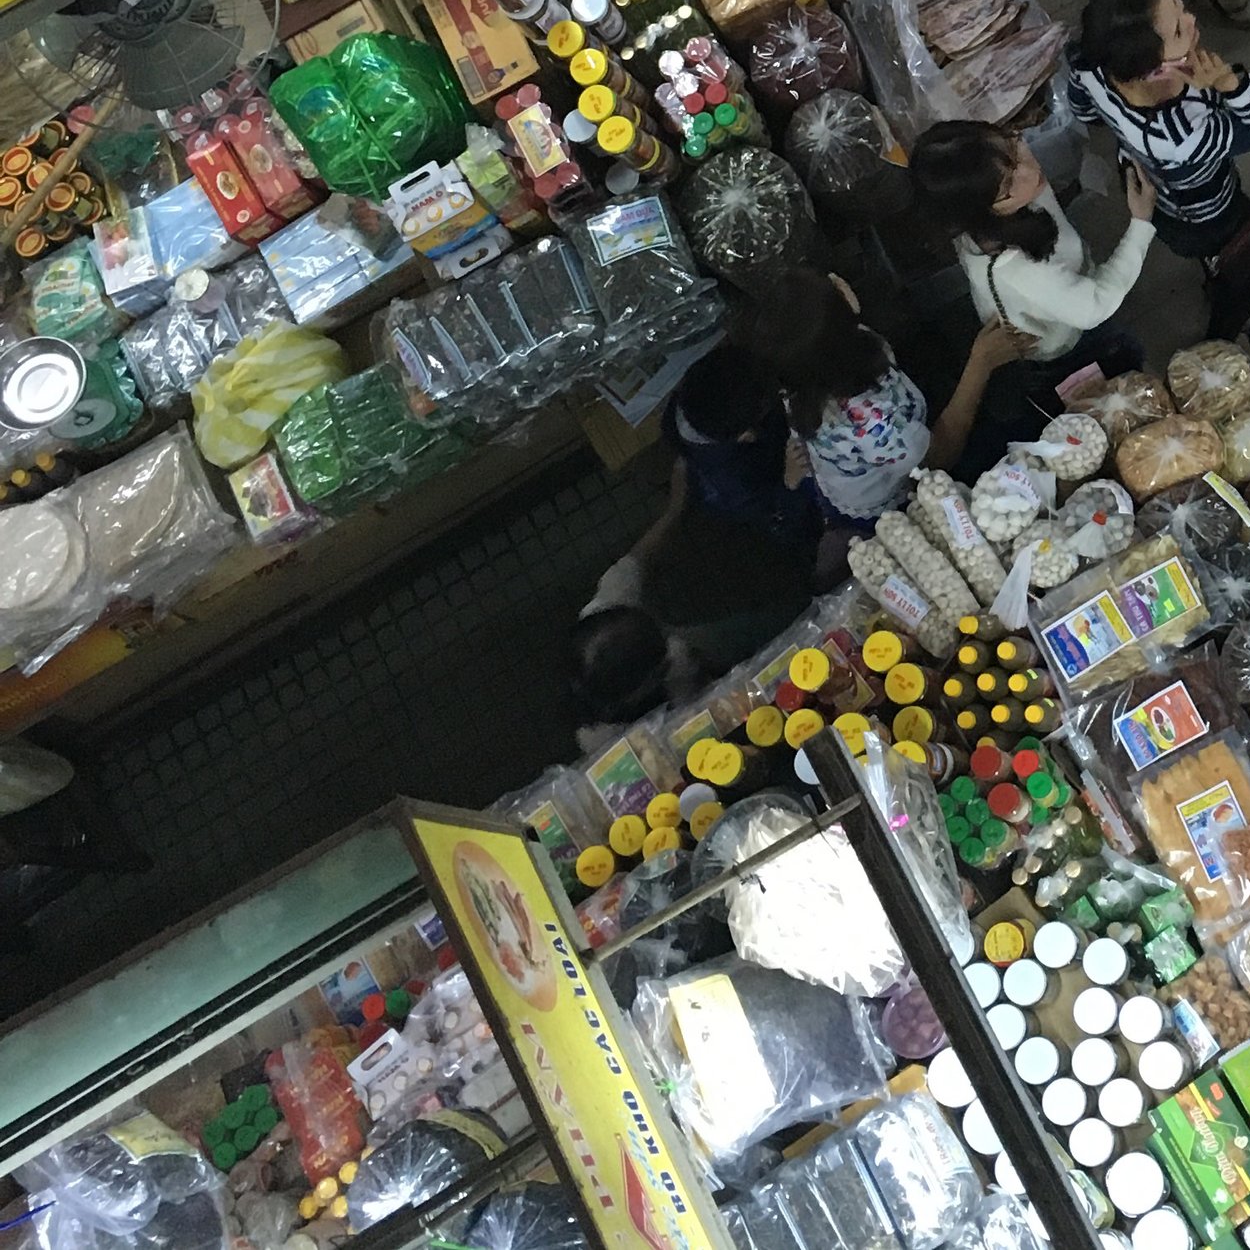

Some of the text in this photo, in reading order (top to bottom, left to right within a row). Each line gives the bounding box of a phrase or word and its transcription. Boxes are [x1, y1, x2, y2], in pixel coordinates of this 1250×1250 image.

[410, 195, 435, 211] NAM
[583, 1007, 623, 1075] CÁC
[622, 1089, 660, 1156] KHÔ
[659, 1170, 687, 1215] BÒ
